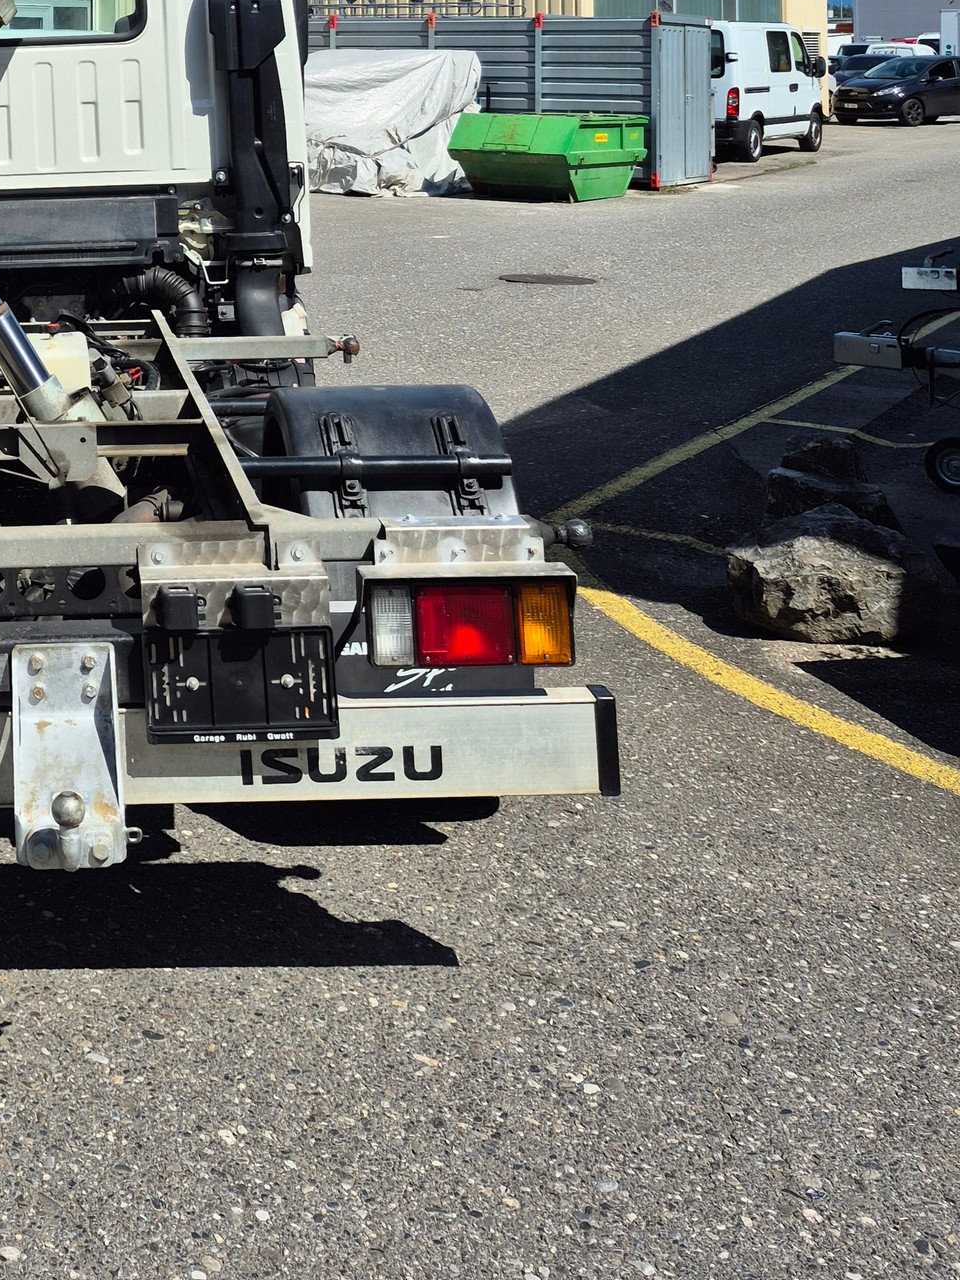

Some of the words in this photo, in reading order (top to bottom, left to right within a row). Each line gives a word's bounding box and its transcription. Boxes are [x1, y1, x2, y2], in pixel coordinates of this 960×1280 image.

[193, 734, 226, 743] Garage
[236, 733, 257, 741] Rubi
[266, 732, 294, 740] Gwatt
[239, 745, 443, 786] ISUZU
